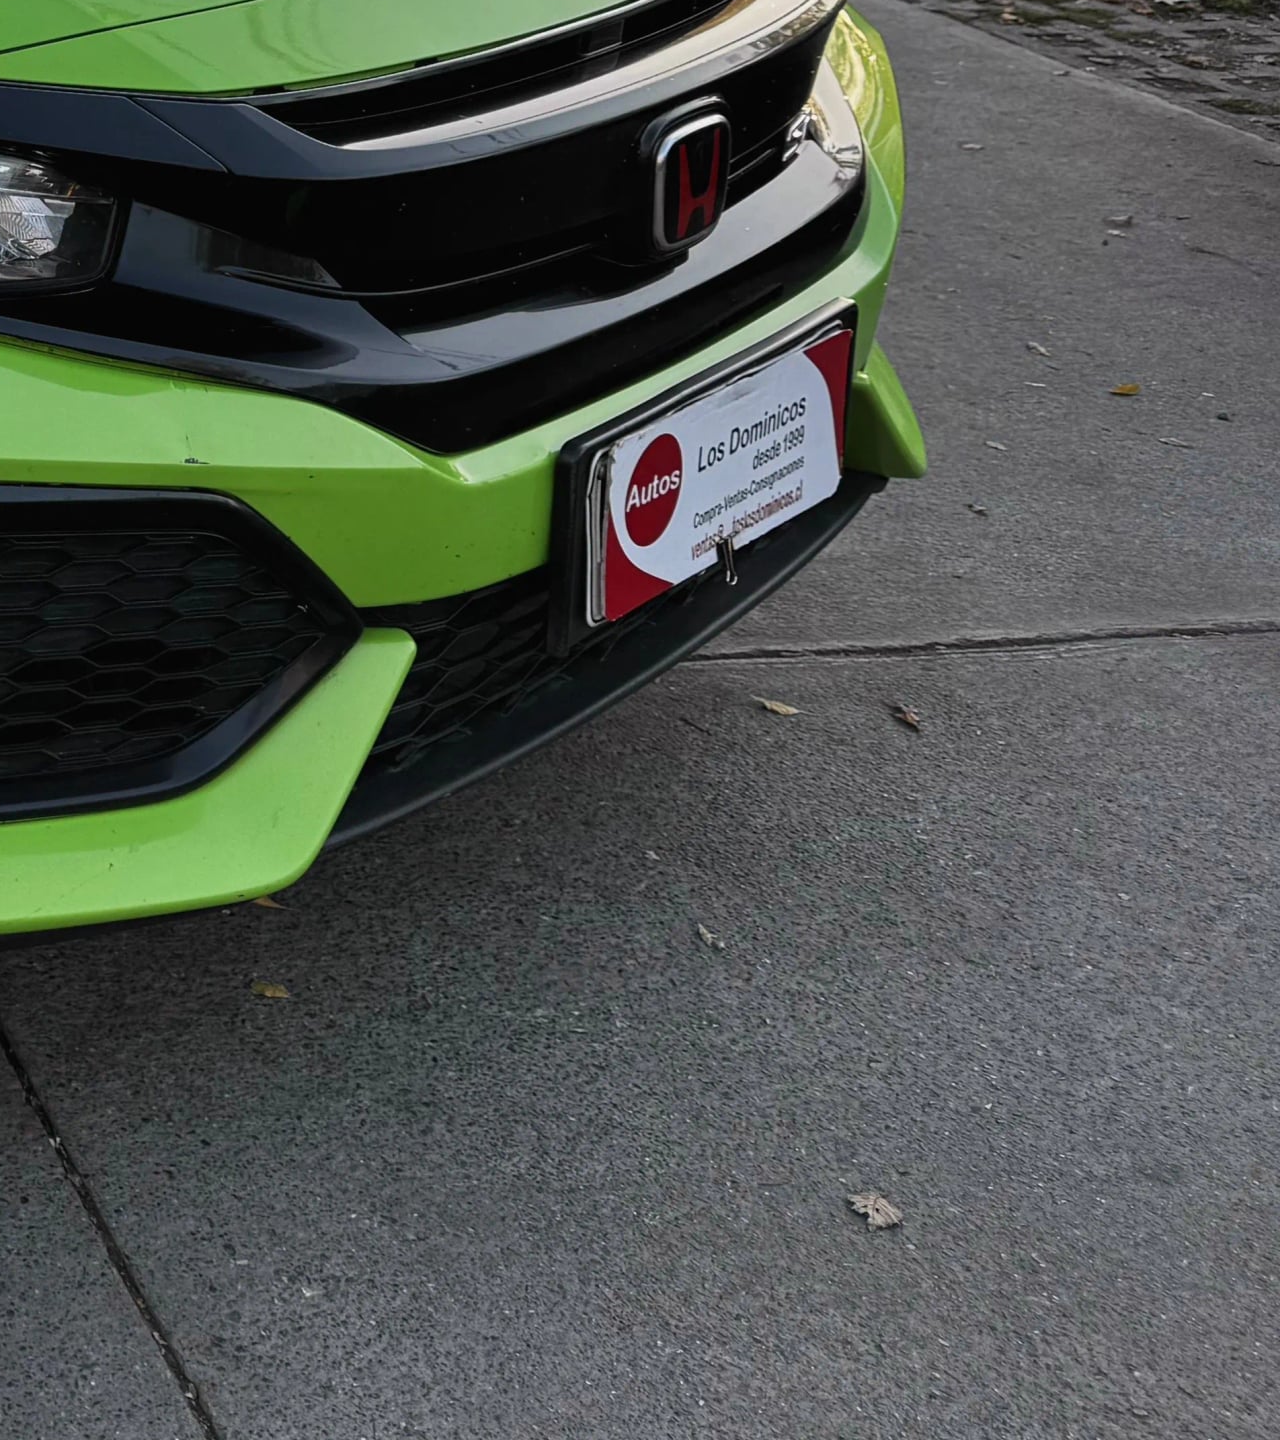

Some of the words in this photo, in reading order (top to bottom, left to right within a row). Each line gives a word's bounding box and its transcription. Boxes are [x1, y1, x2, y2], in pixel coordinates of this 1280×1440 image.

[698, 444, 725, 473] Los
[729, 397, 806, 455] Dominicos
[753, 439, 782, 470] desde
[783, 425, 805, 453] 1999
[626, 469, 681, 513] Autos
